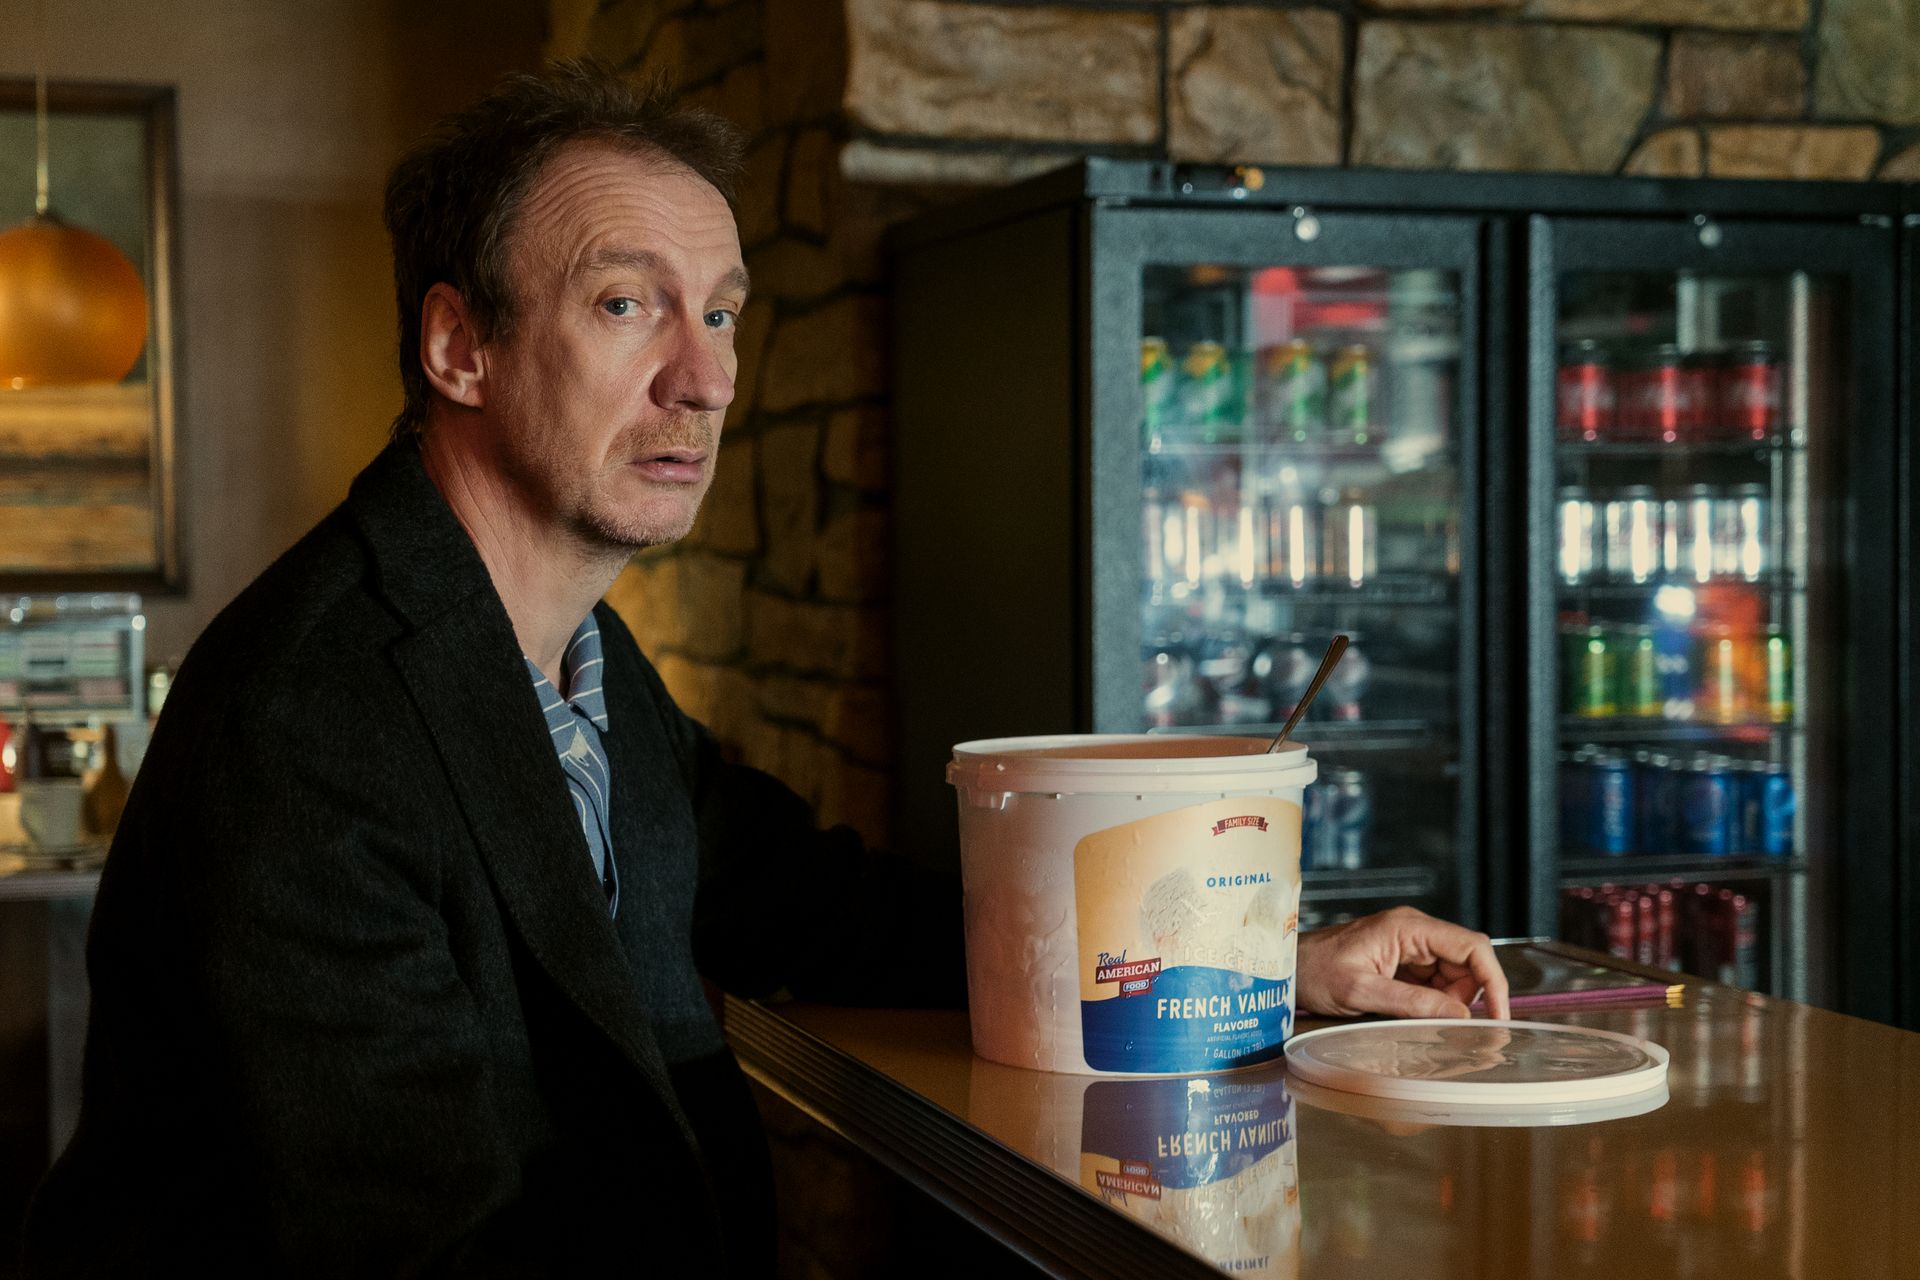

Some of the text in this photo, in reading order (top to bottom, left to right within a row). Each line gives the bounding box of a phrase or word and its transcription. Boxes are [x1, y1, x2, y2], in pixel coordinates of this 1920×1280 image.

[1224, 816, 1260, 829] FAMILY SIZE
[1206, 872, 1271, 888] ORIGINAL
[1098, 949, 1127, 967] Real
[1184, 946, 1281, 979] ICE CREAM
[1097, 961, 1160, 980] AMERICAN
[1125, 981, 1147, 991] FOOD
[1157, 984, 1287, 1019] FRENCH VANILLA
[1213, 1018, 1259, 1033] FLAVORED
[1204, 1047, 1209, 1057] 1
[1213, 1048, 1241, 1059] GALLON
